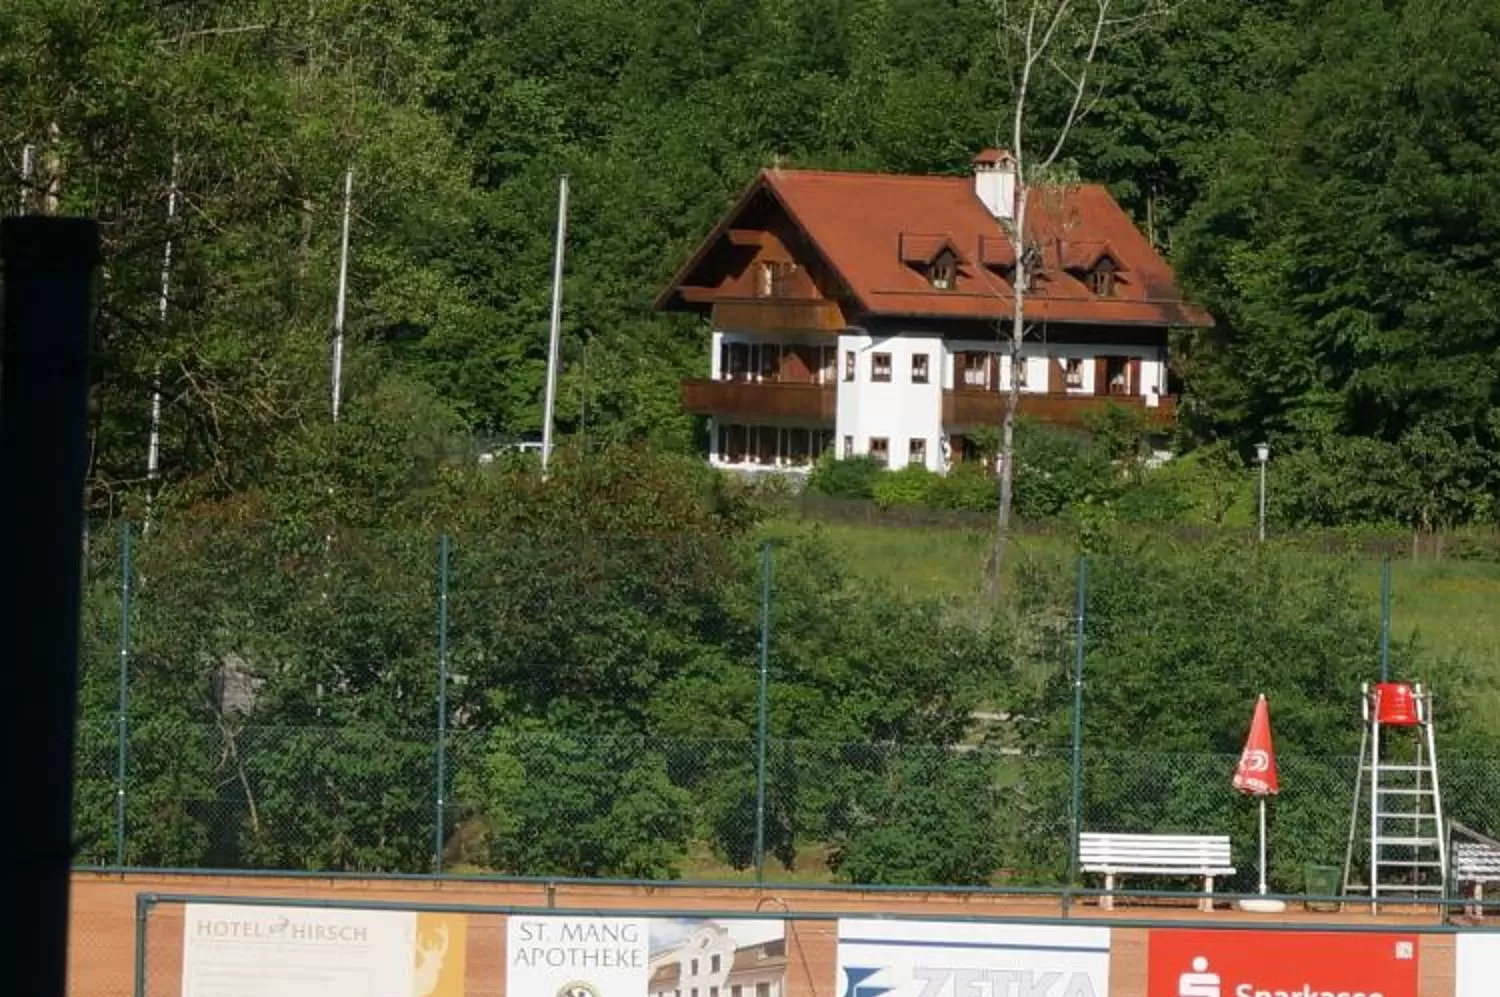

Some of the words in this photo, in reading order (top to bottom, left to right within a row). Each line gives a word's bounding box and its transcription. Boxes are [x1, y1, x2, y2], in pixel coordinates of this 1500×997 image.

[196, 919, 262, 938] HOTEL
[291, 923, 367, 942] HIRSCH
[519, 921, 551, 942] ST.
[559, 922, 639, 943] MANG
[513, 946, 643, 969] APOTHEKE
